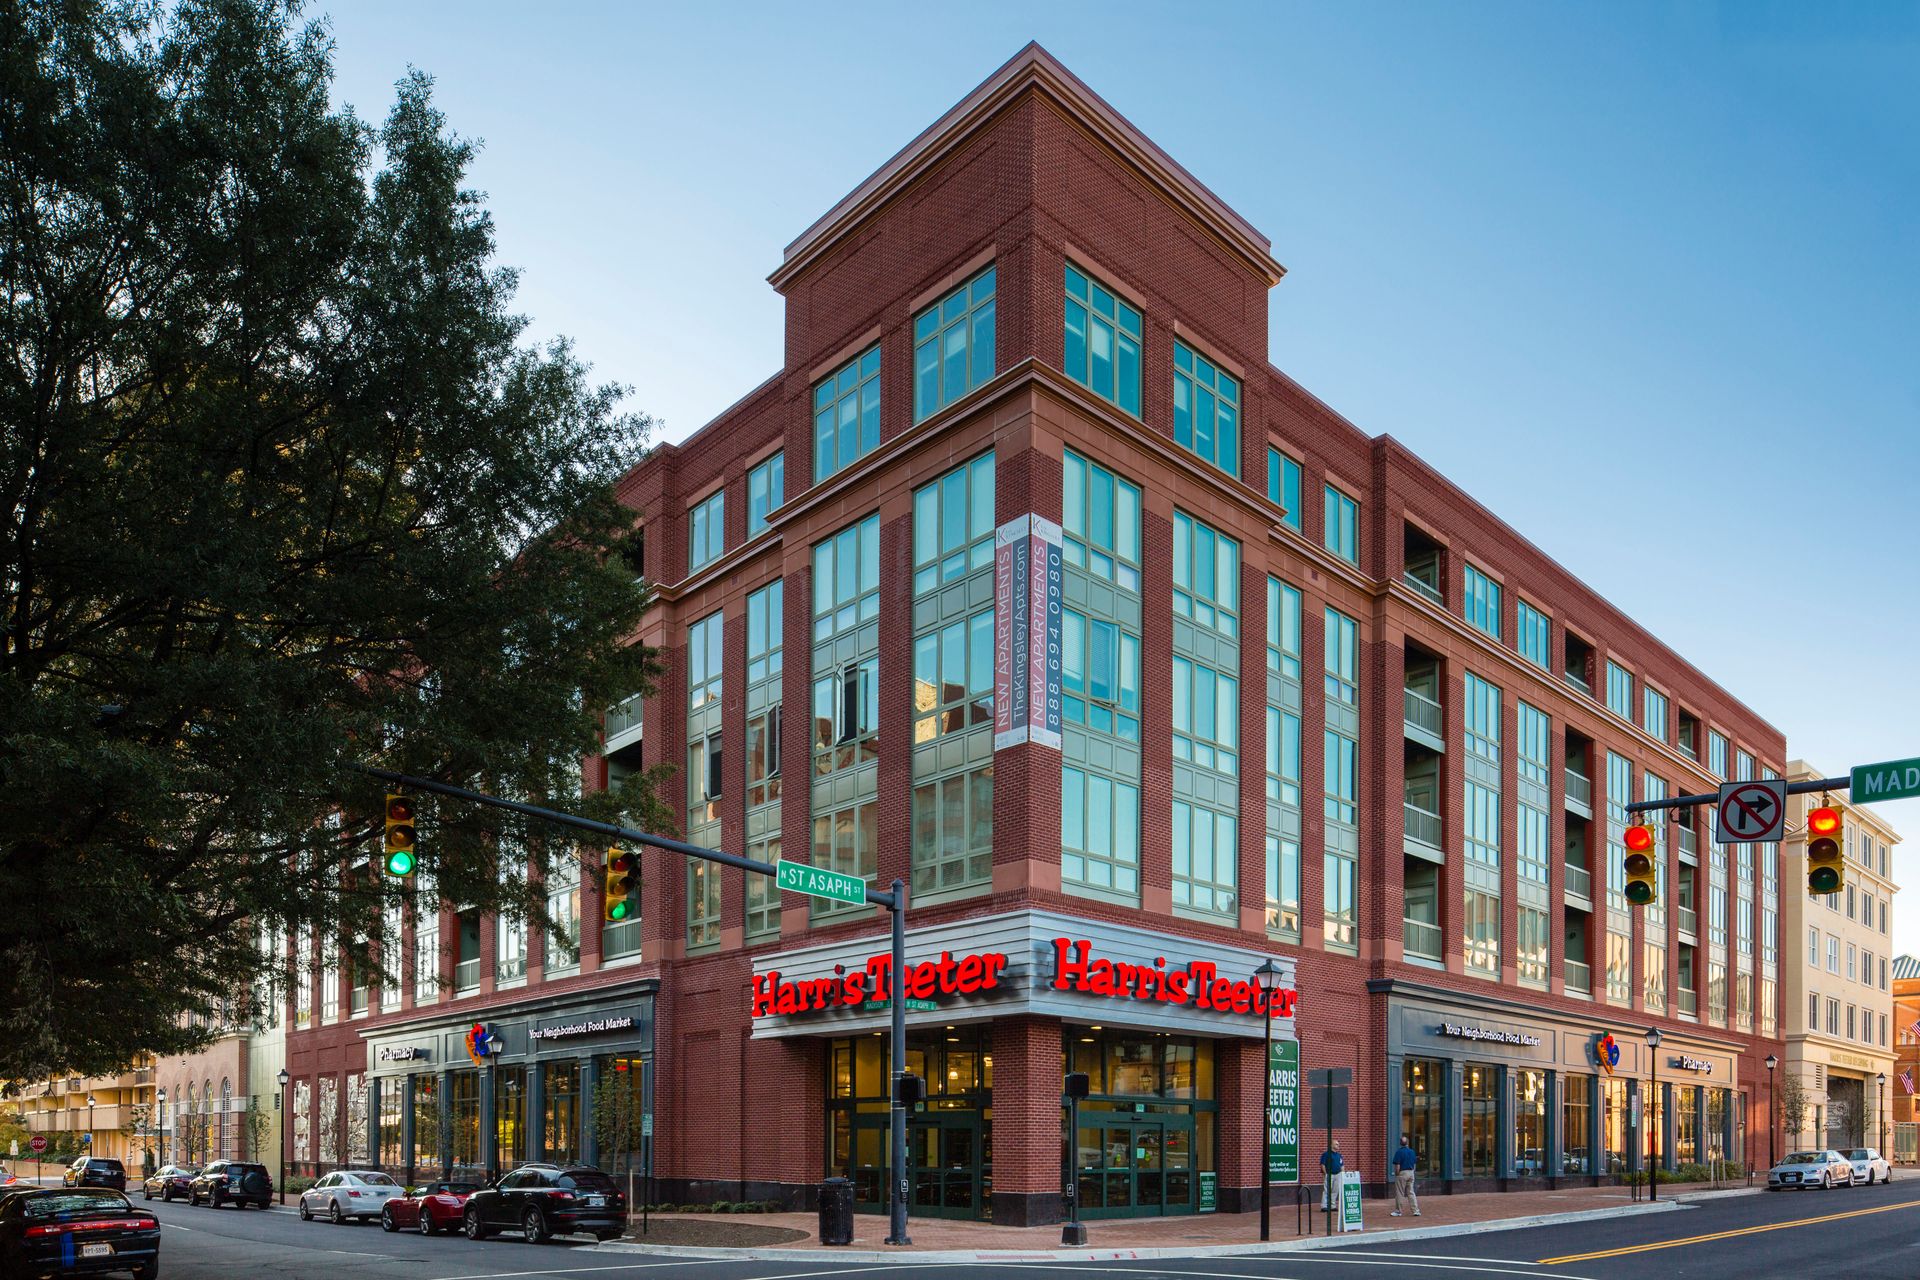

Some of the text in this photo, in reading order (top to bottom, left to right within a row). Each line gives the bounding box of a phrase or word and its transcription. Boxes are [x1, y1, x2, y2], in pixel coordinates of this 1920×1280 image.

[998, 551, 1010, 727] NEW APARTMENTS
[1014, 544, 1027, 721] TheKingsleyApts.com
[1033, 545, 1045, 720] NEW APARTMENTS
[1049, 553, 1060, 726] 888.694.0980
[1865, 767, 1920, 795] MAD
[781, 868, 861, 896] N ST ASAPH ST
[752, 951, 1008, 1018] Harris Teeter
[1052, 937, 1298, 1018] Harris Teeter
[529, 1017, 631, 1039] Your Neighborhood Food Market
[1445, 1023, 1540, 1046] Your Neighborhood Food Market
[379, 1046, 415, 1061] Pharmacy
[1683, 1056, 1713, 1074] Pharmacy
[1269, 1069, 1297, 1088] ARRIS
[1269, 1089, 1295, 1107] EETER
[1269, 1127, 1296, 1145] IRING
